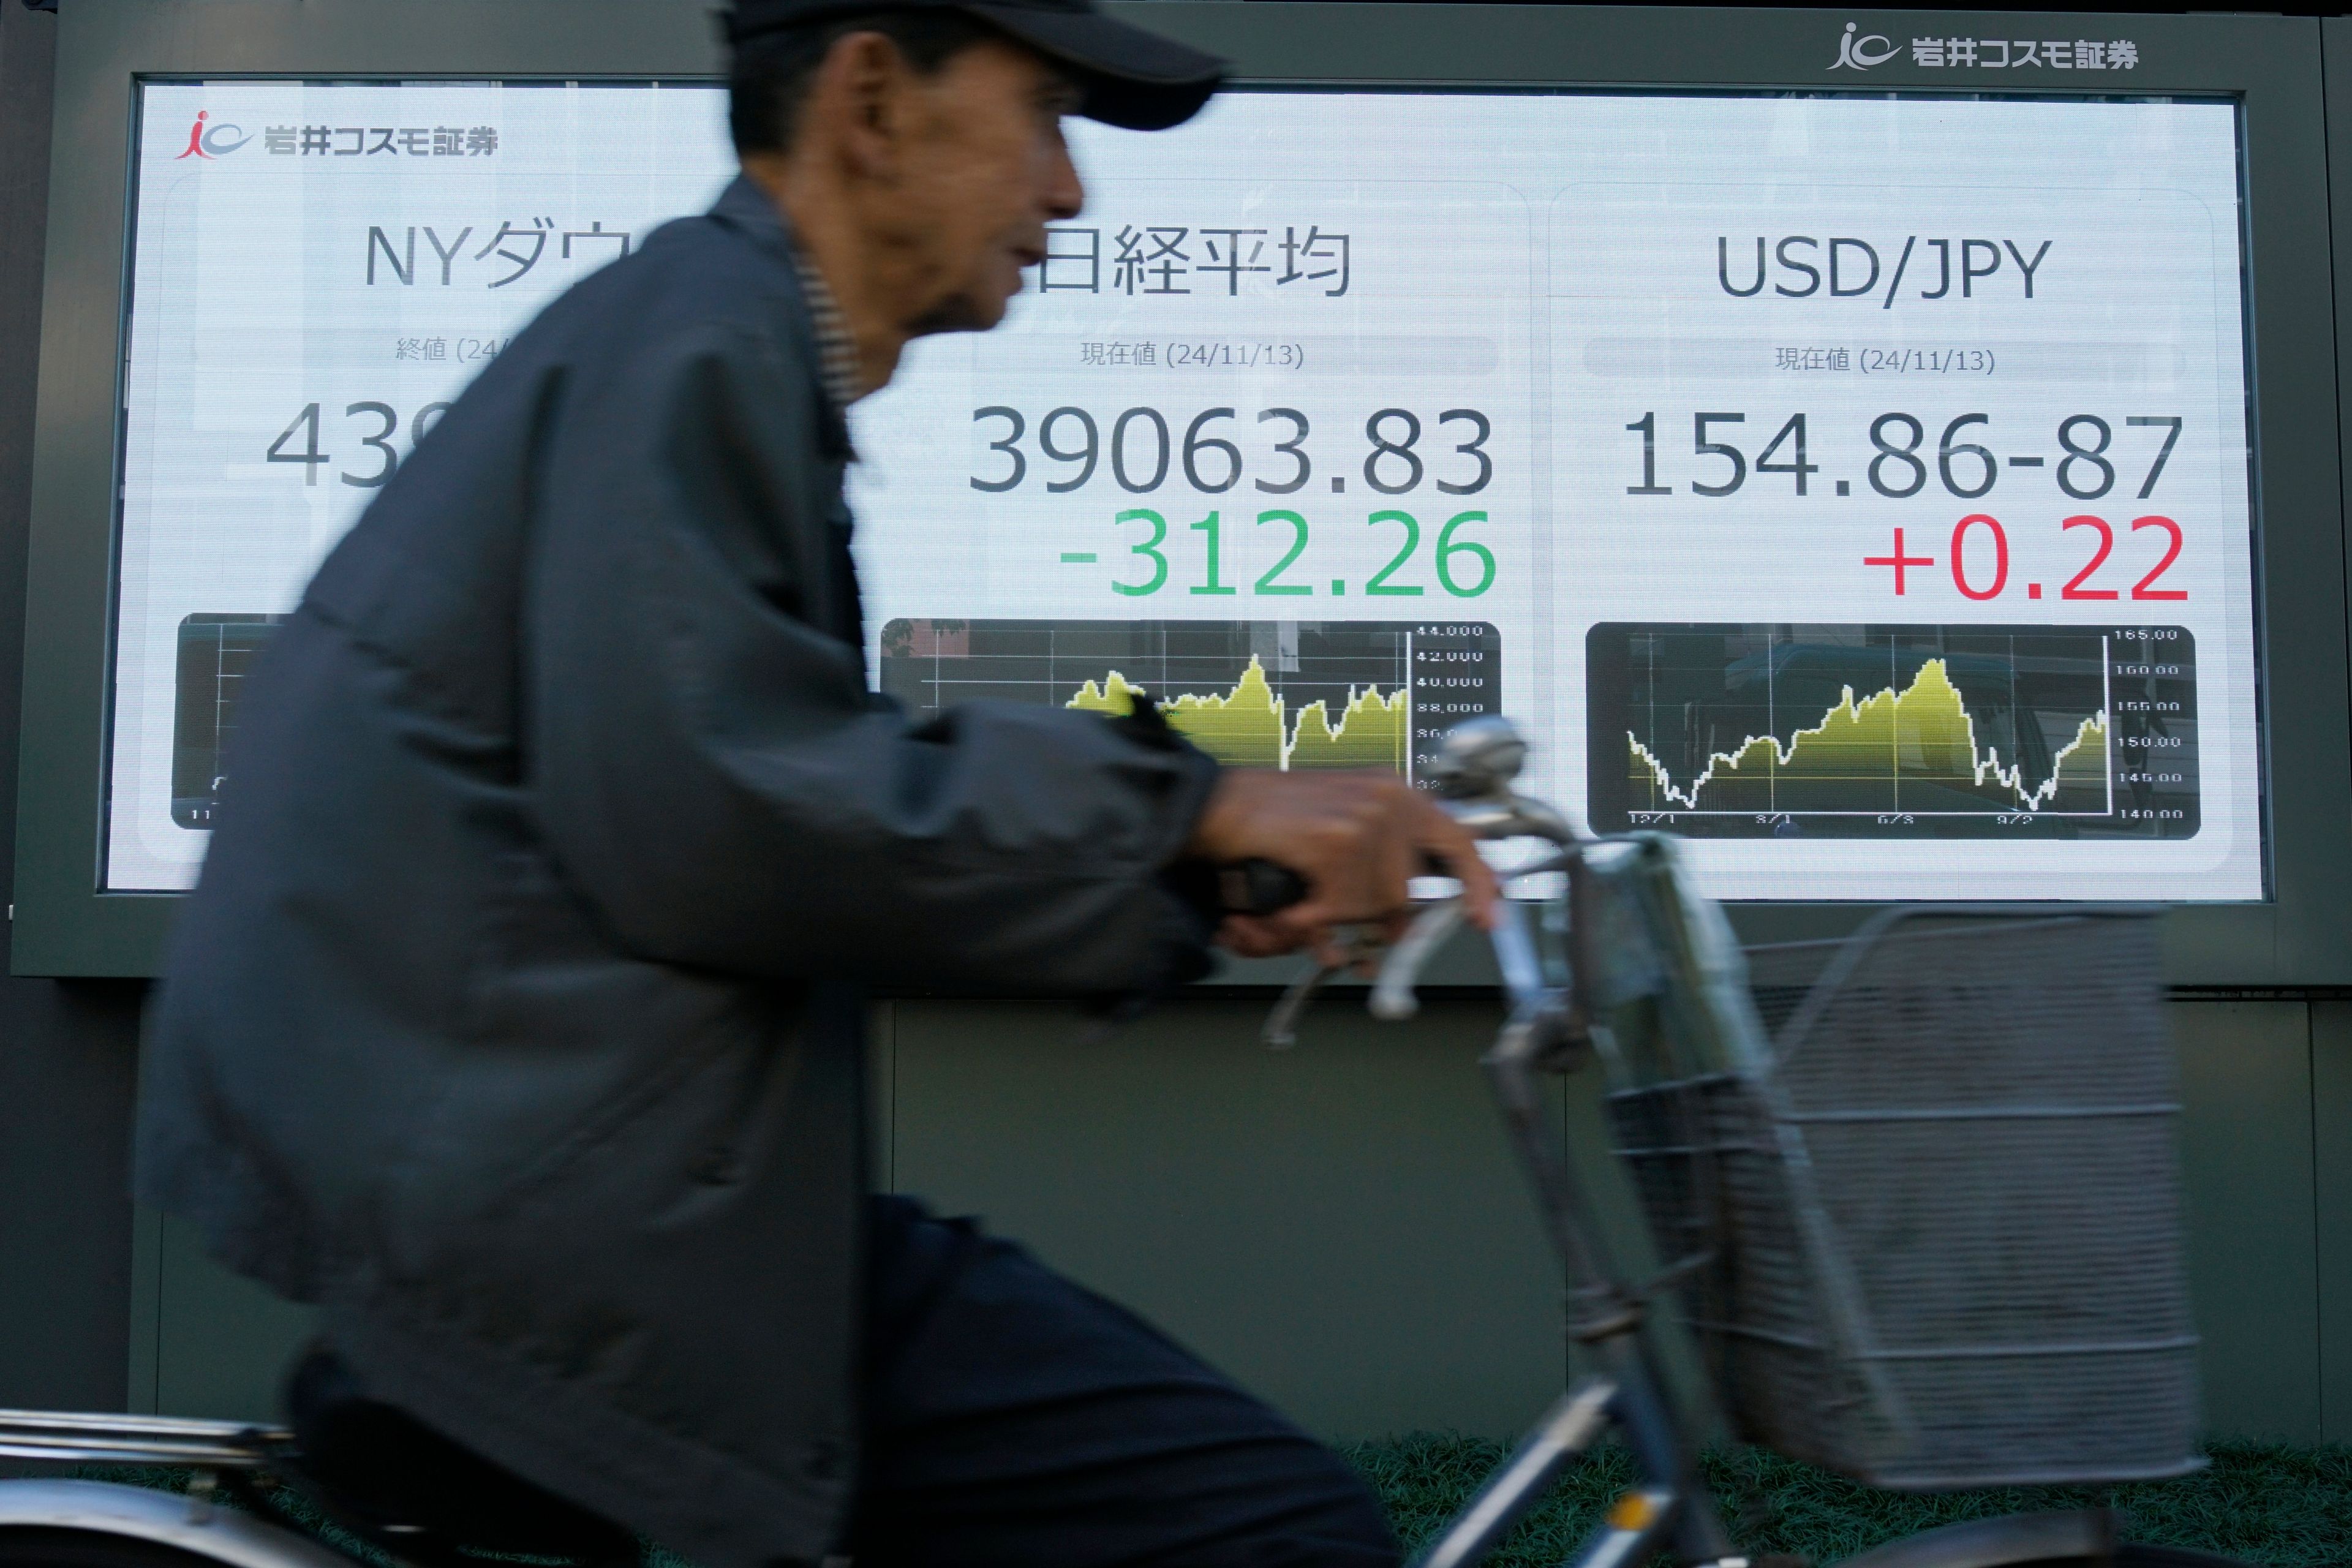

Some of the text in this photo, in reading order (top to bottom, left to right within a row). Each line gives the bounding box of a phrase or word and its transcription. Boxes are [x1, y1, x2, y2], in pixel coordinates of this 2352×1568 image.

[1912, 37, 2138, 69] 岩井コスモ証券
[264, 124, 499, 156] 岩井コスモ証券
[1039, 224, 1349, 297] 日経平均
[1717, 236, 2052, 310] USD/JPY
[396, 337, 447, 360] 終値
[1080, 342, 1304, 370] 現在値 (24/11/13)
[1776, 347, 1996, 375] 現在値 (24/11/13)
[970, 406, 1493, 496] 39063.83
[1626, 412, 2182, 500] 154.86-87
[1060, 508, 1496, 598] -312.26
[1864, 514, 2188, 601] +0.22
